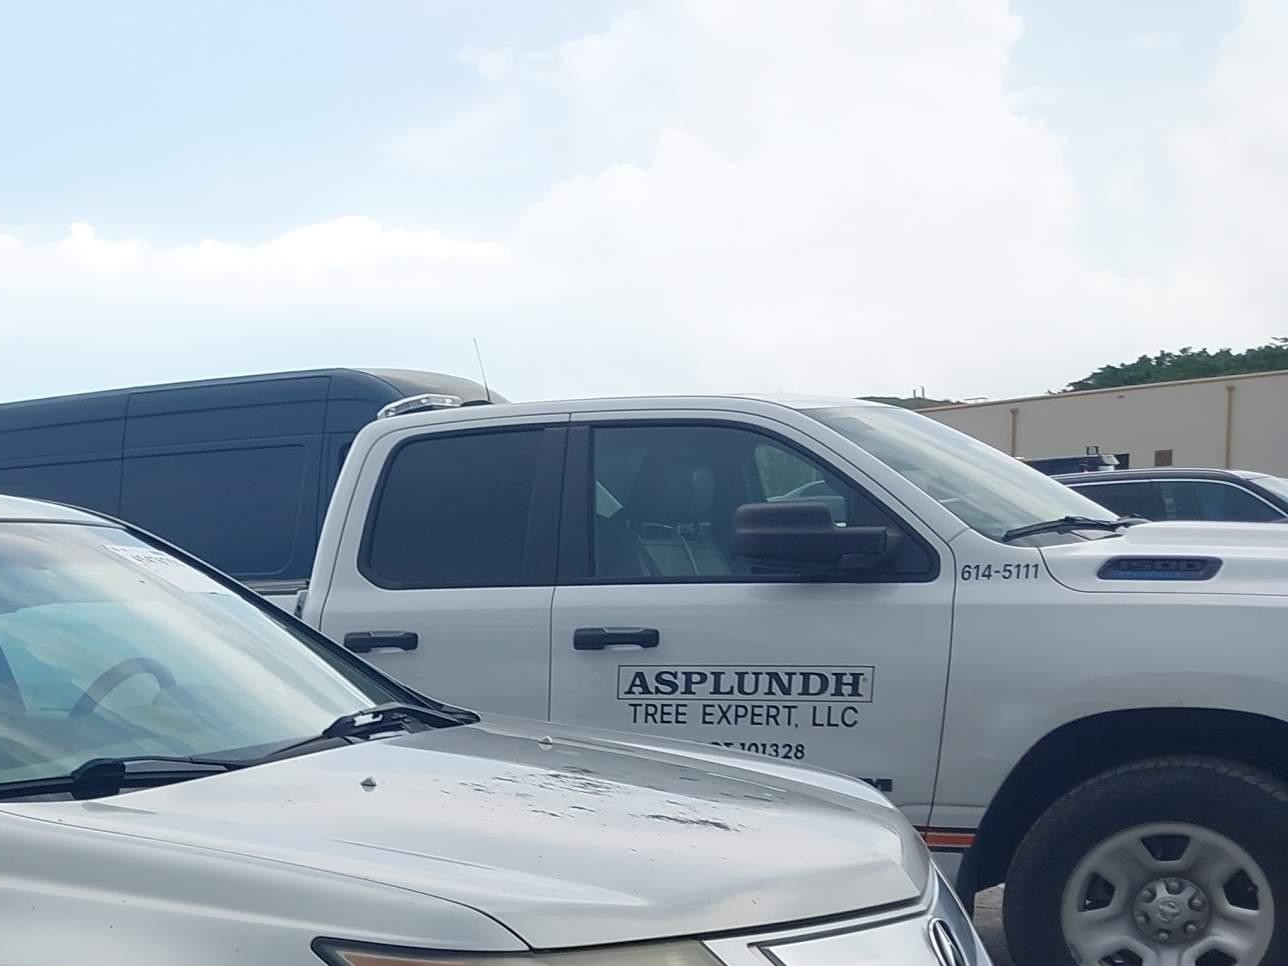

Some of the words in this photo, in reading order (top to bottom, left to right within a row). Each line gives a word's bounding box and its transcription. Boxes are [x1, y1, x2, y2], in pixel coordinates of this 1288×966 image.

[961, 564, 1038, 580] 614-5111
[623, 670, 864, 698] ASPLUNDH
[628, 704, 687, 724] TREE
[701, 704, 798, 728] EXPERT,
[812, 705, 859, 728] LLC
